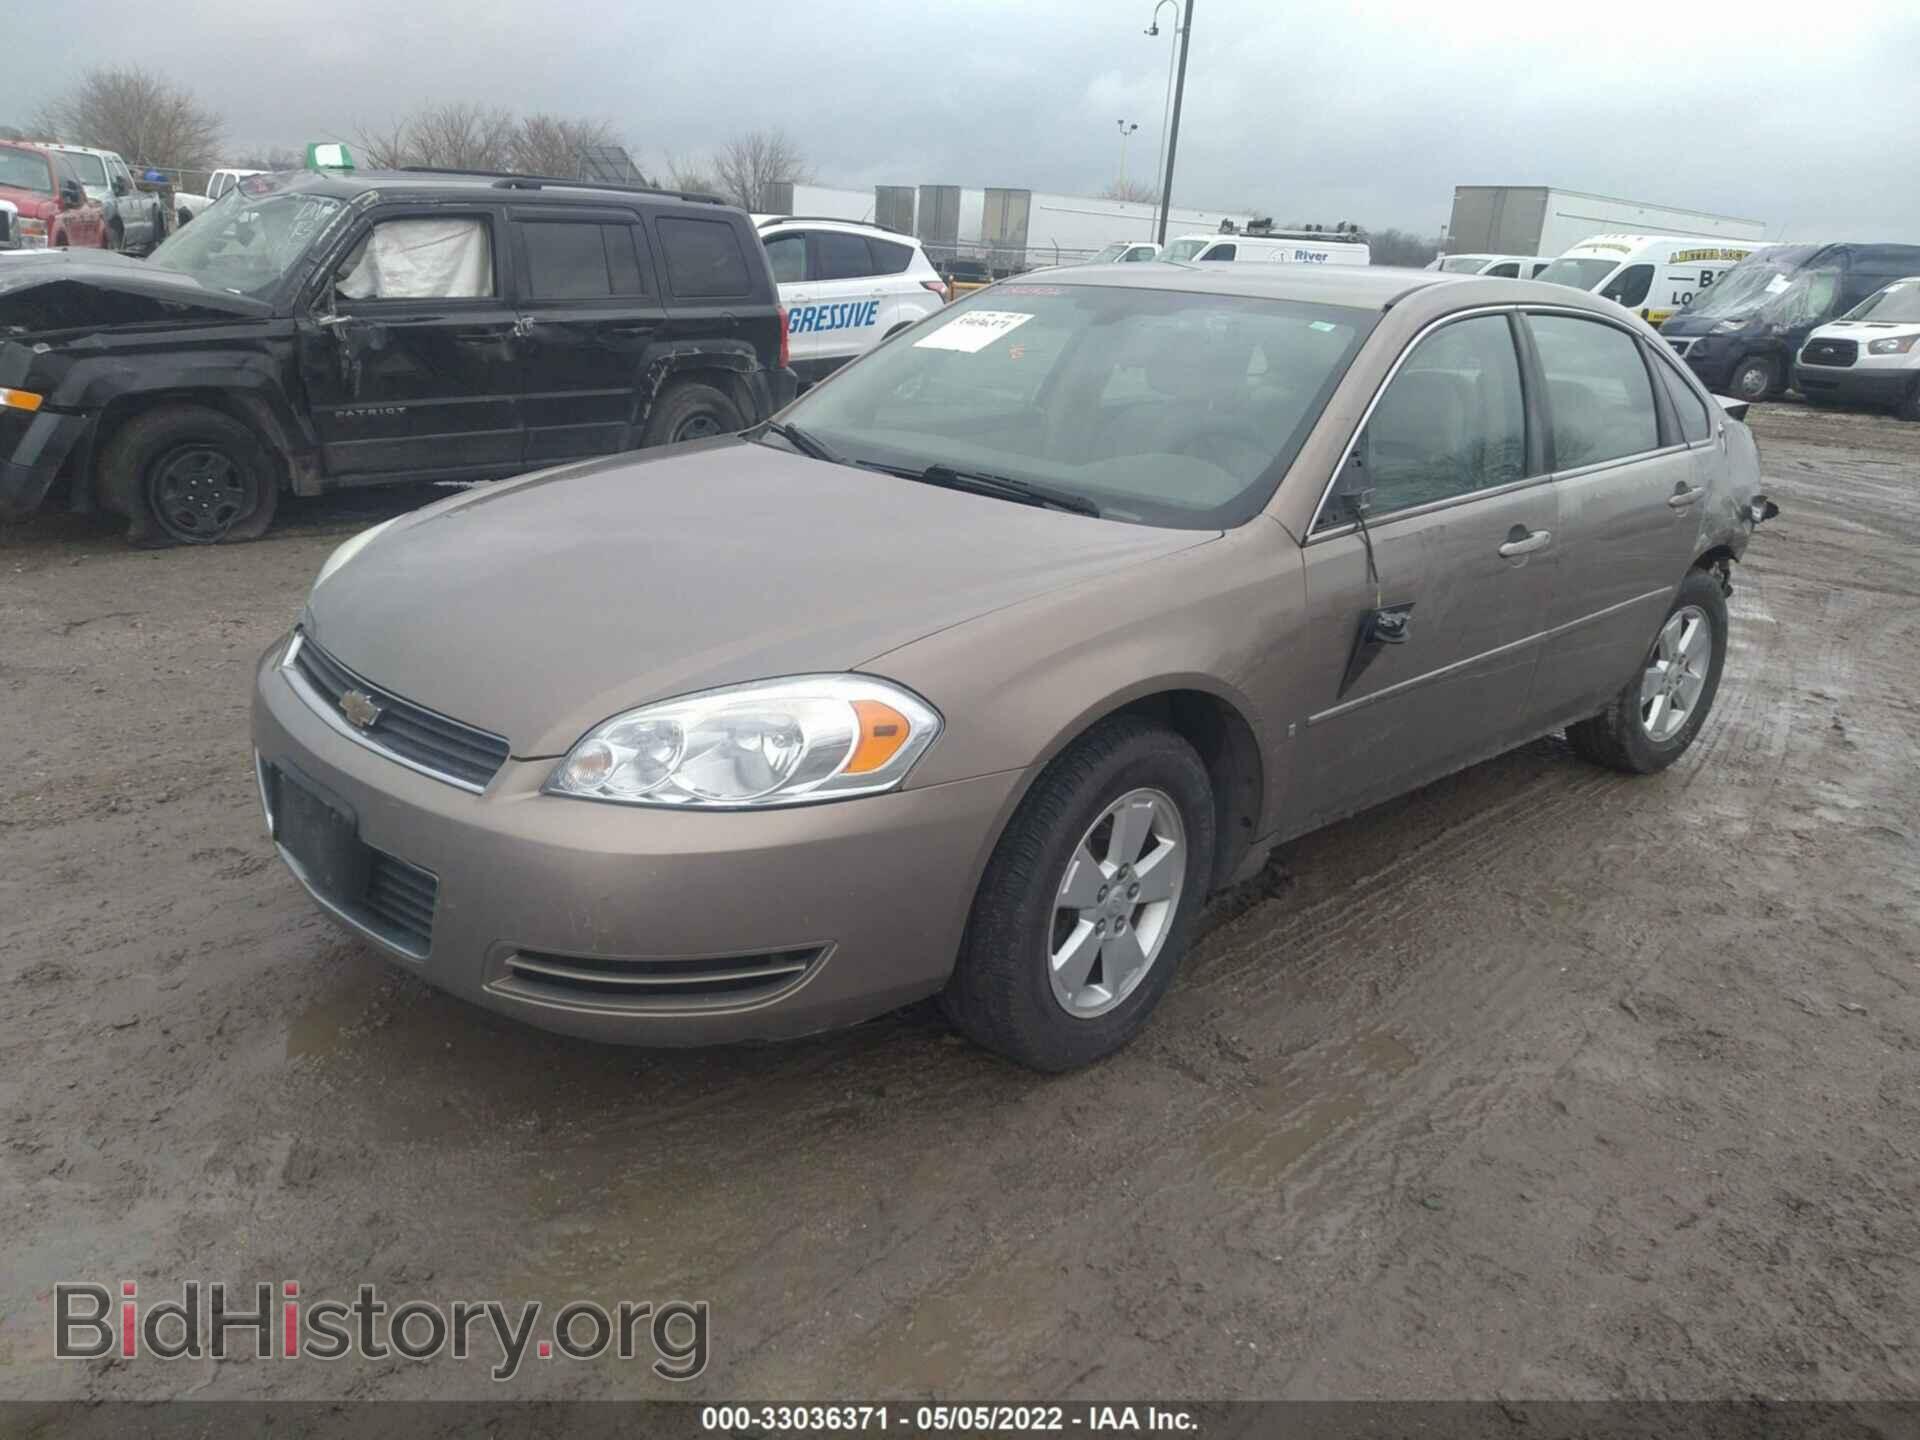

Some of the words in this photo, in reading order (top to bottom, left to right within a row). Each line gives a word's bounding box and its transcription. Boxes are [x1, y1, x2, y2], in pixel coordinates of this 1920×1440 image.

[1295, 250, 1328, 262] River
[788, 301, 880, 334] GRESSIVE
[335, 407, 407, 417] PATRIOT
